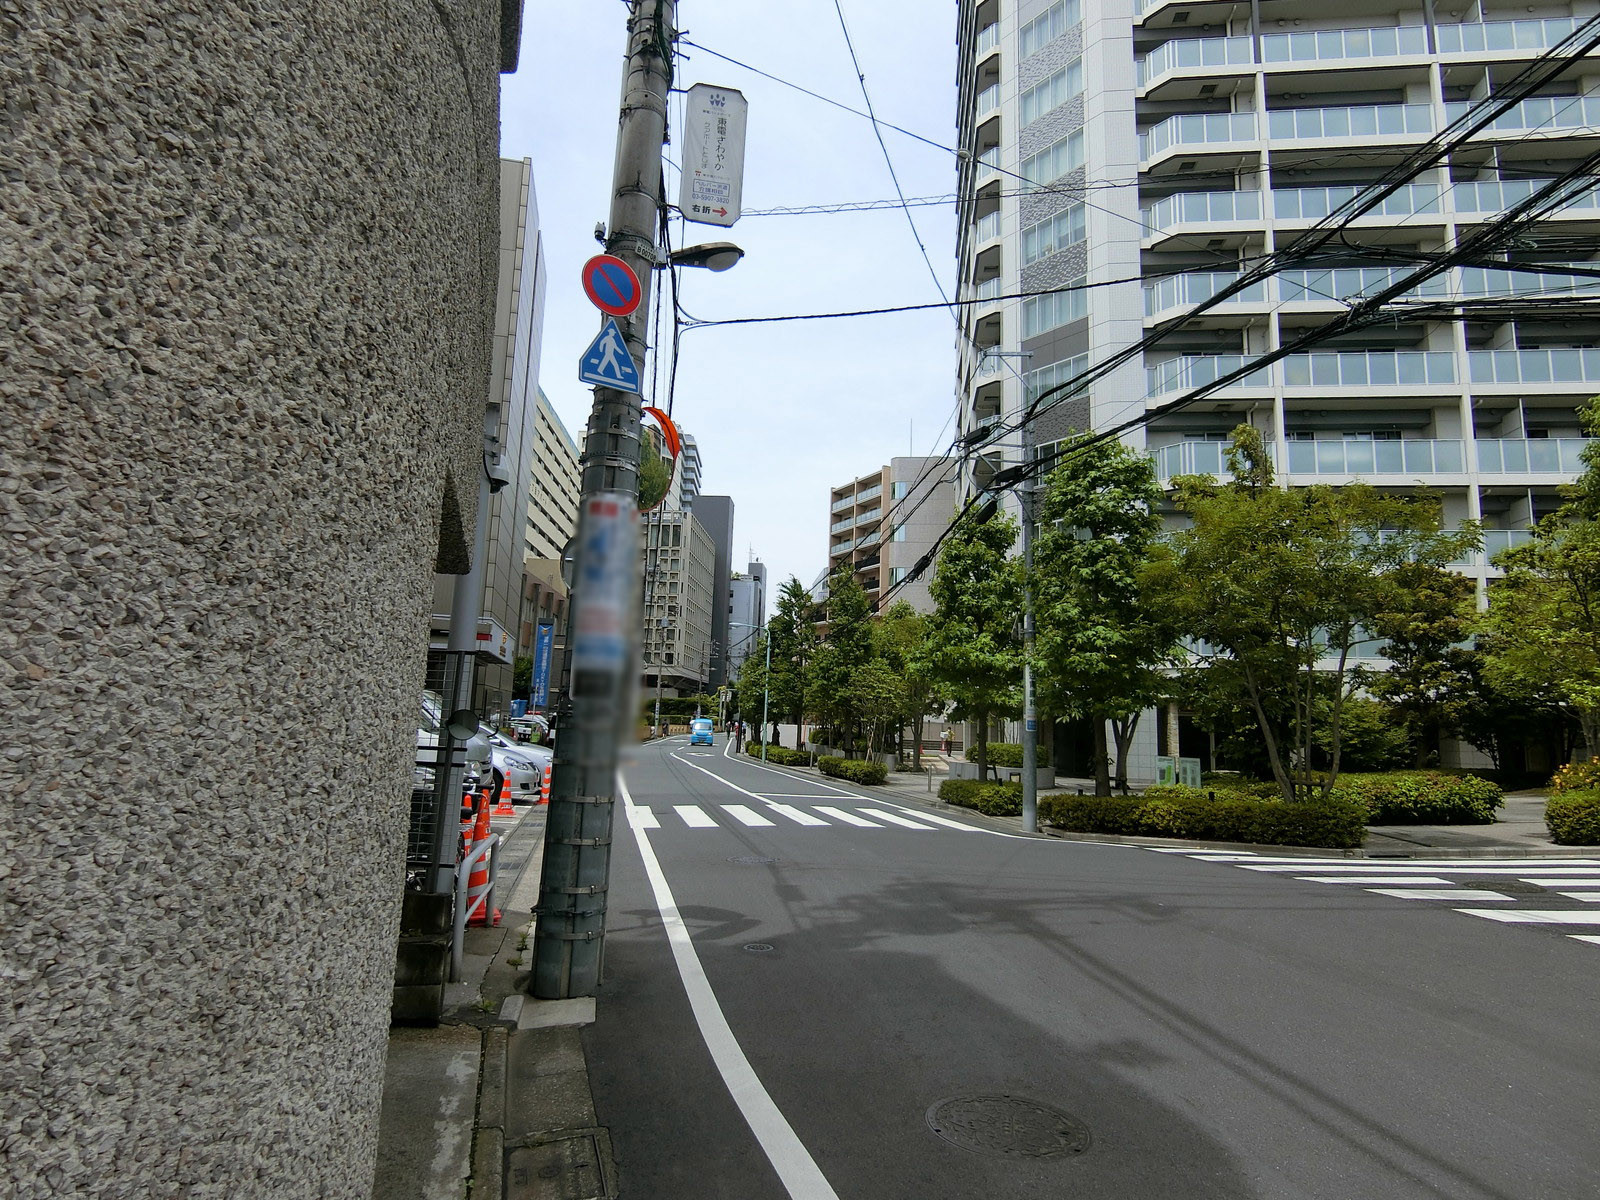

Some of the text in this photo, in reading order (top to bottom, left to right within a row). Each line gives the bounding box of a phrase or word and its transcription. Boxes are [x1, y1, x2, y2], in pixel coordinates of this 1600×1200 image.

[714, 117, 727, 171] 東電さわやか
[691, 204, 711, 215] 右折
